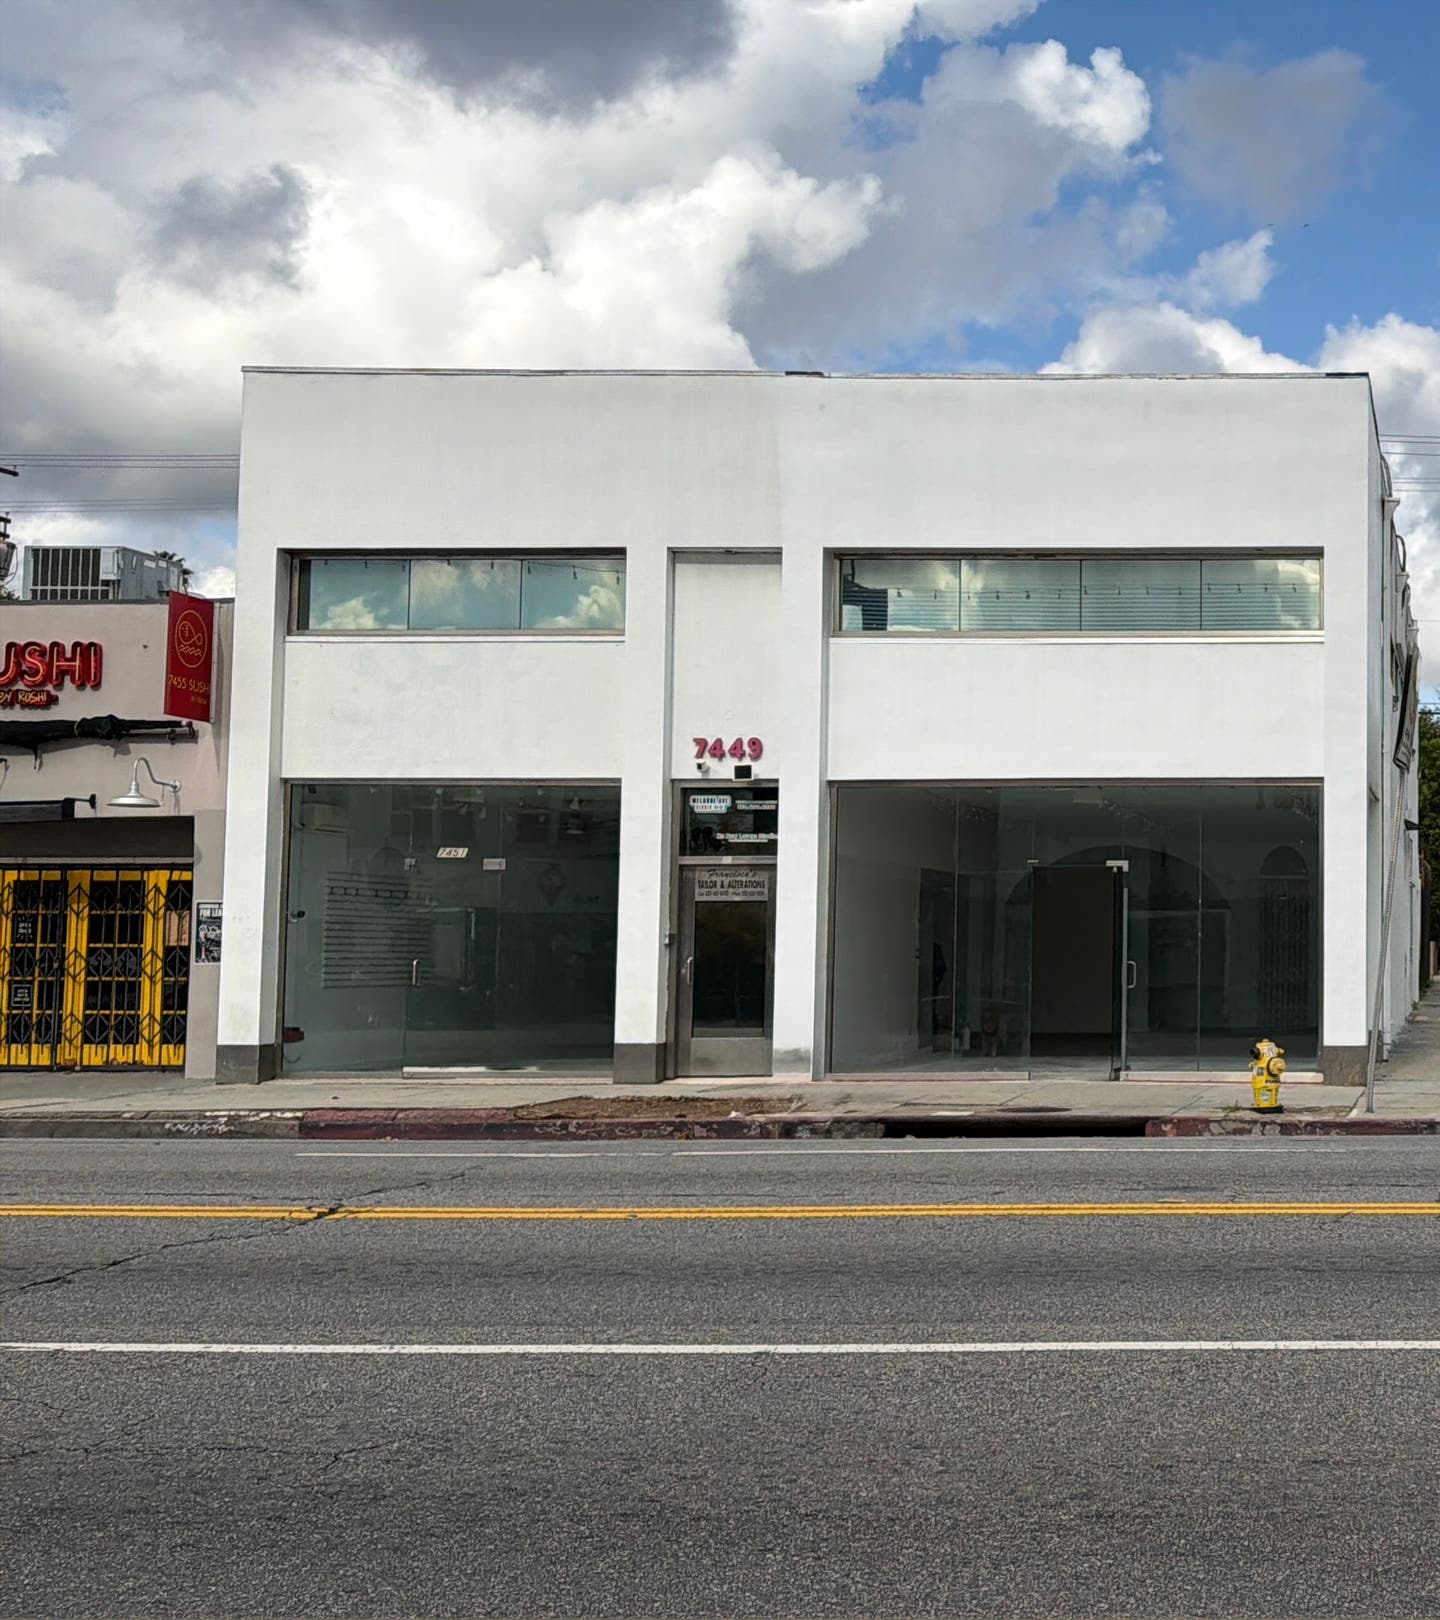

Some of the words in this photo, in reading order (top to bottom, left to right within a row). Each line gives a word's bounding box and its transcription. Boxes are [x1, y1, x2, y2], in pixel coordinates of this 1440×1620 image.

[692, 737, 763, 762] 7449
[439, 849, 465, 857] 7451
[698, 880, 717, 889] TAILOR
[720, 880, 725, 889] &
[727, 880, 766, 889] ALTERATIONS
